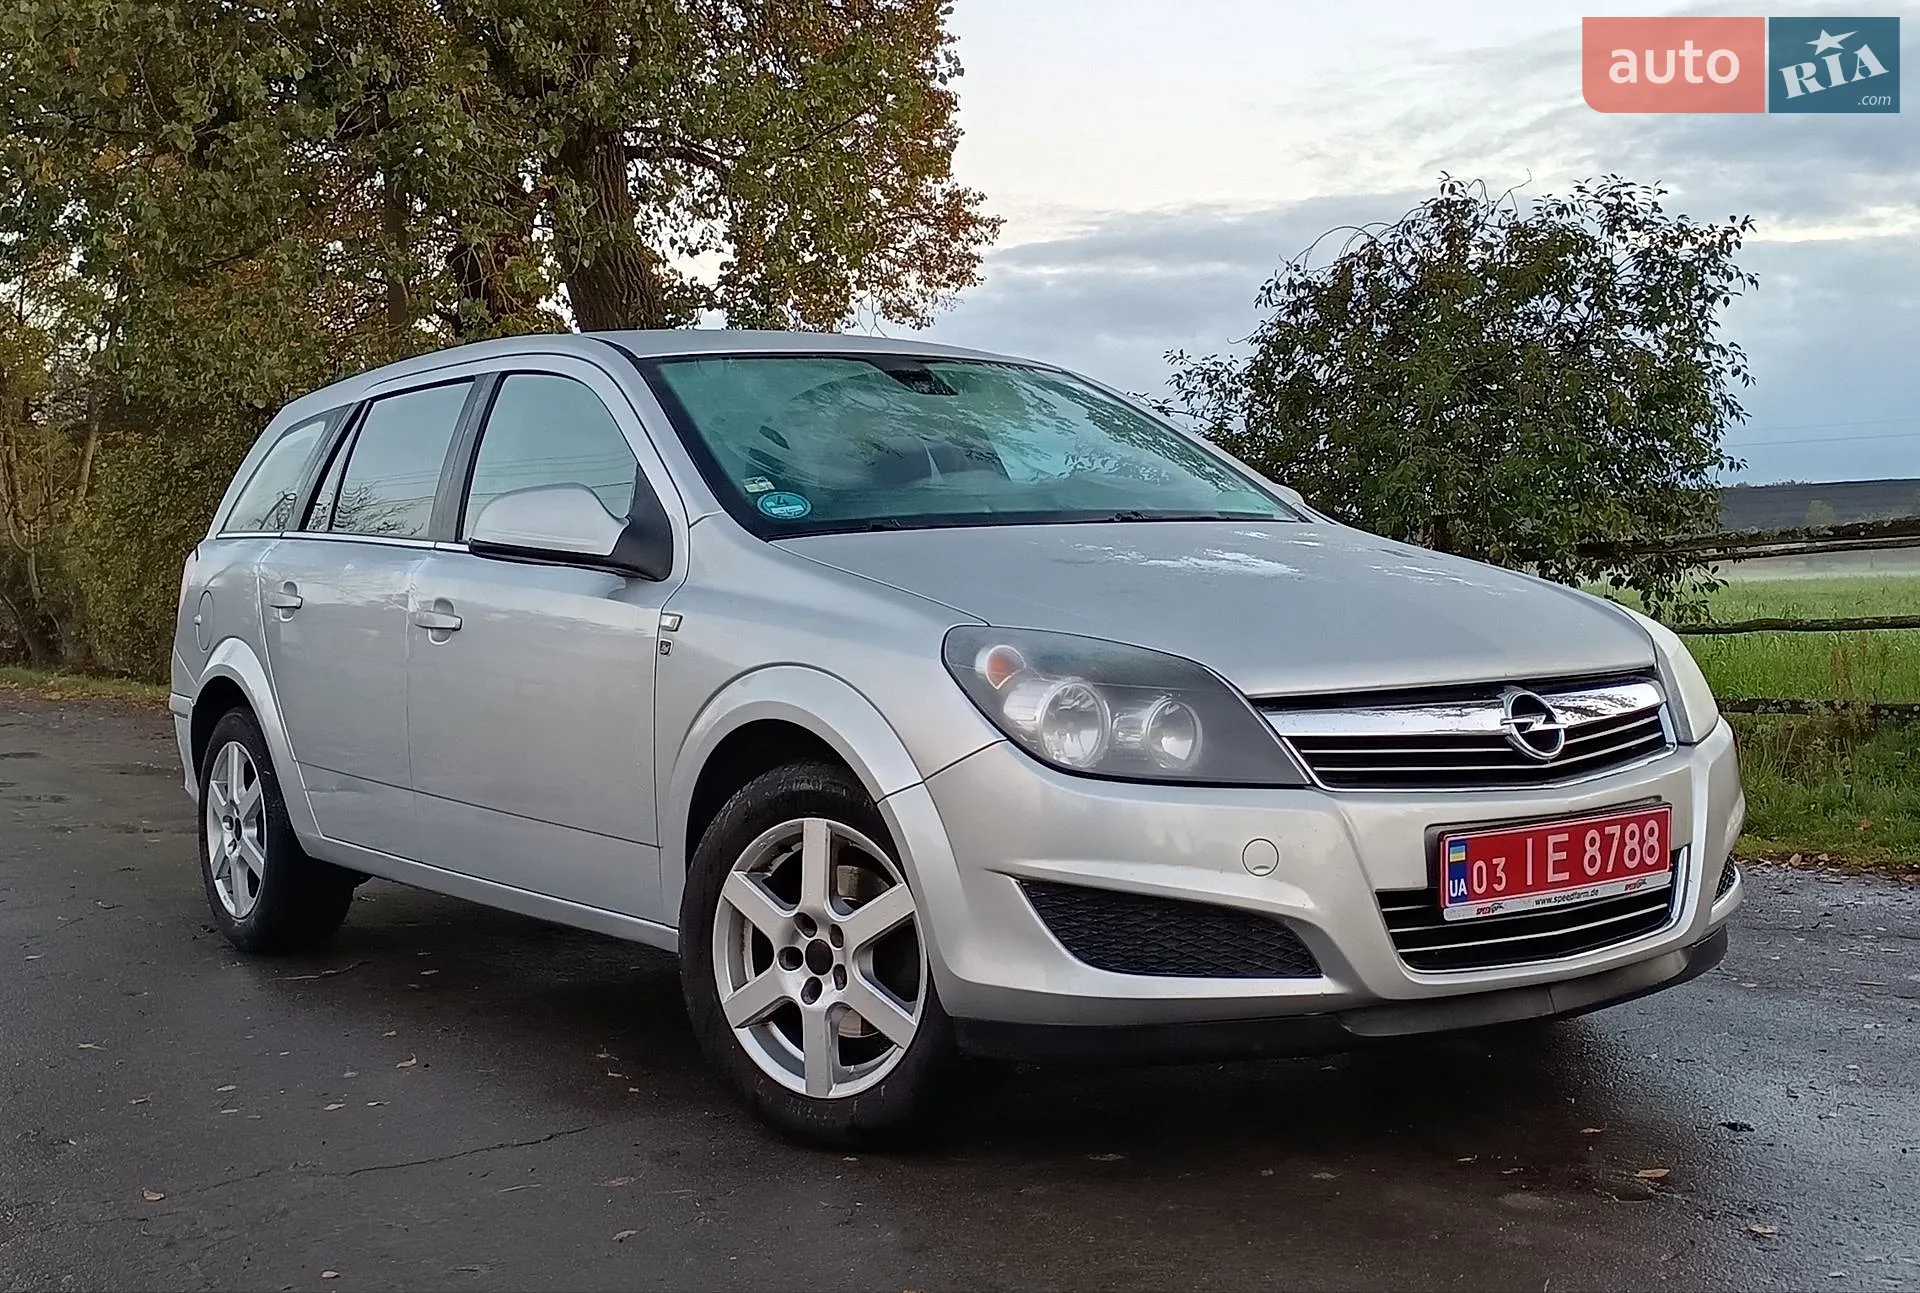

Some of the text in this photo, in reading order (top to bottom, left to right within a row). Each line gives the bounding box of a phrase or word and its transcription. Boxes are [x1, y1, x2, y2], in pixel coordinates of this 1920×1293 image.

[1472, 819, 1660, 895] 03 IE 8788
[1449, 878, 1468, 897] UA
[1534, 888, 1599, 906] www.speedfarm.de
